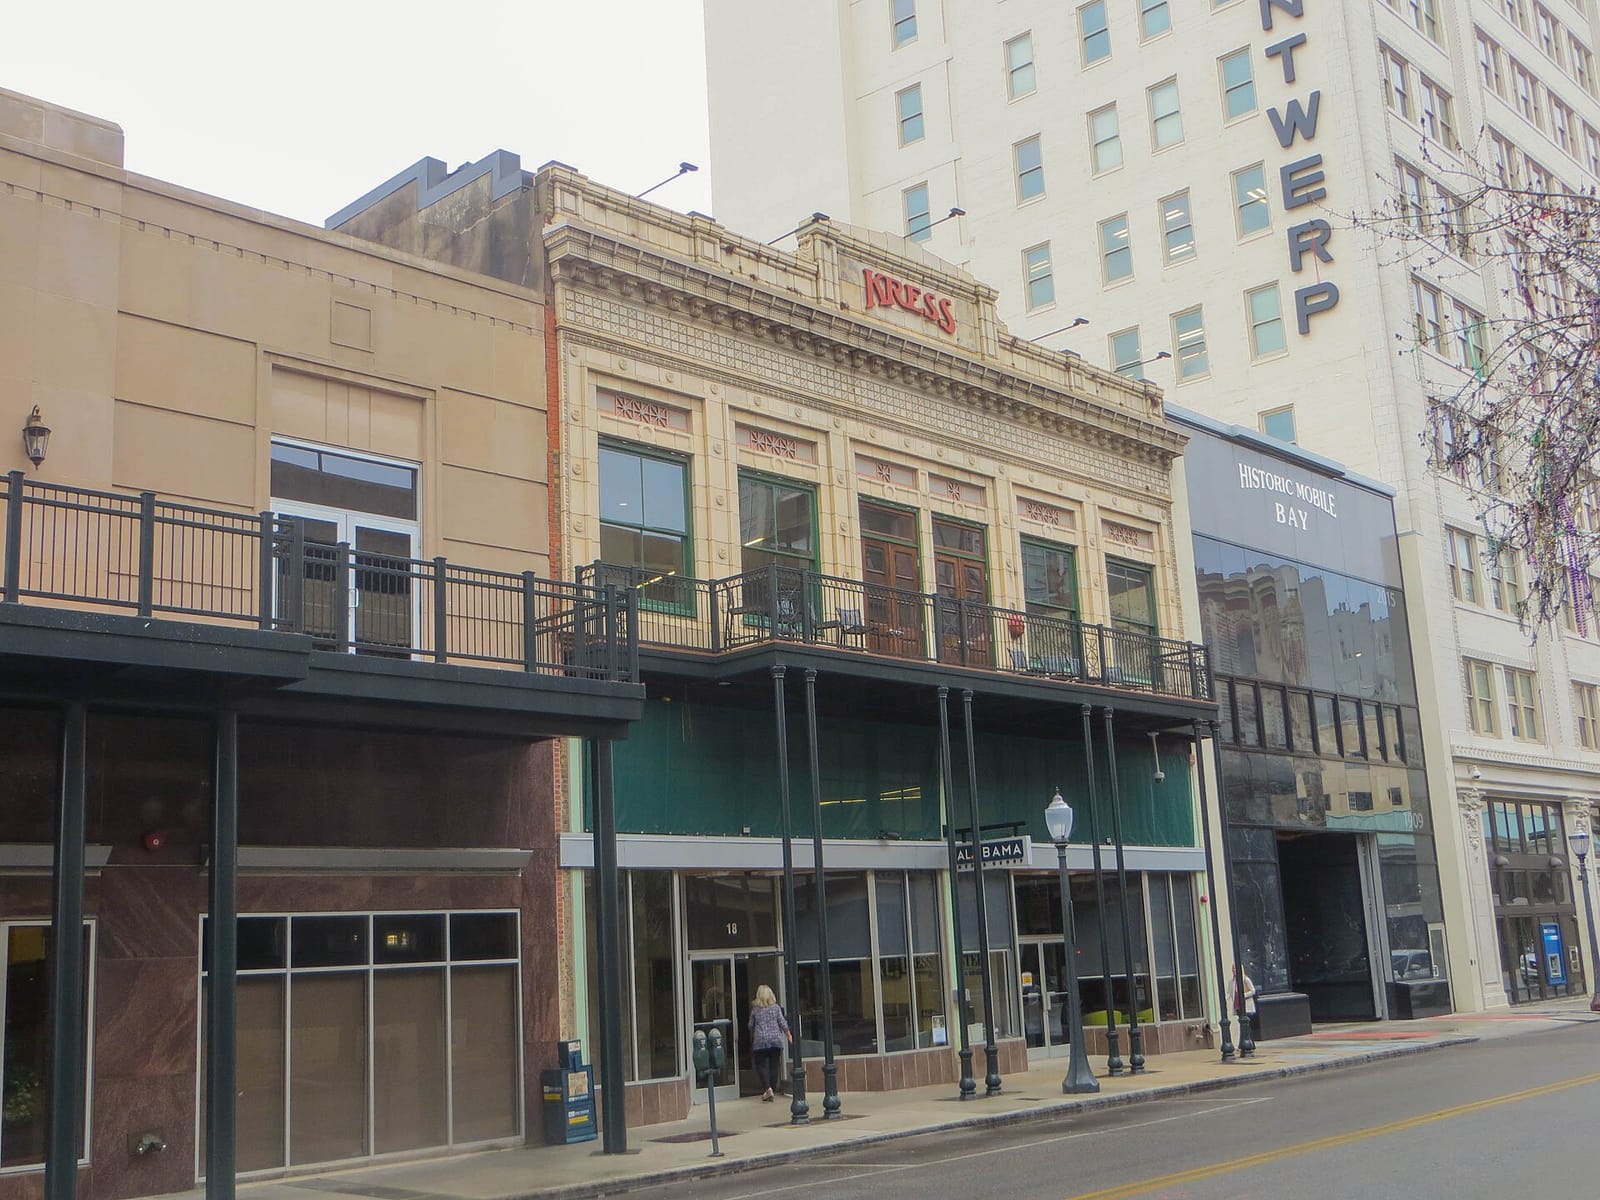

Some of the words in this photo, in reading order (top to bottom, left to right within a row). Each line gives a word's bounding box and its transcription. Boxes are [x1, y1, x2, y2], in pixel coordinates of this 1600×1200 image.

[862, 268, 956, 335] KRESS
[1238, 463, 1294, 496] HISTORIC
[1295, 482, 1337, 518] MOBILE
[1275, 502, 1308, 531] BAY
[726, 922, 738, 935] 18
